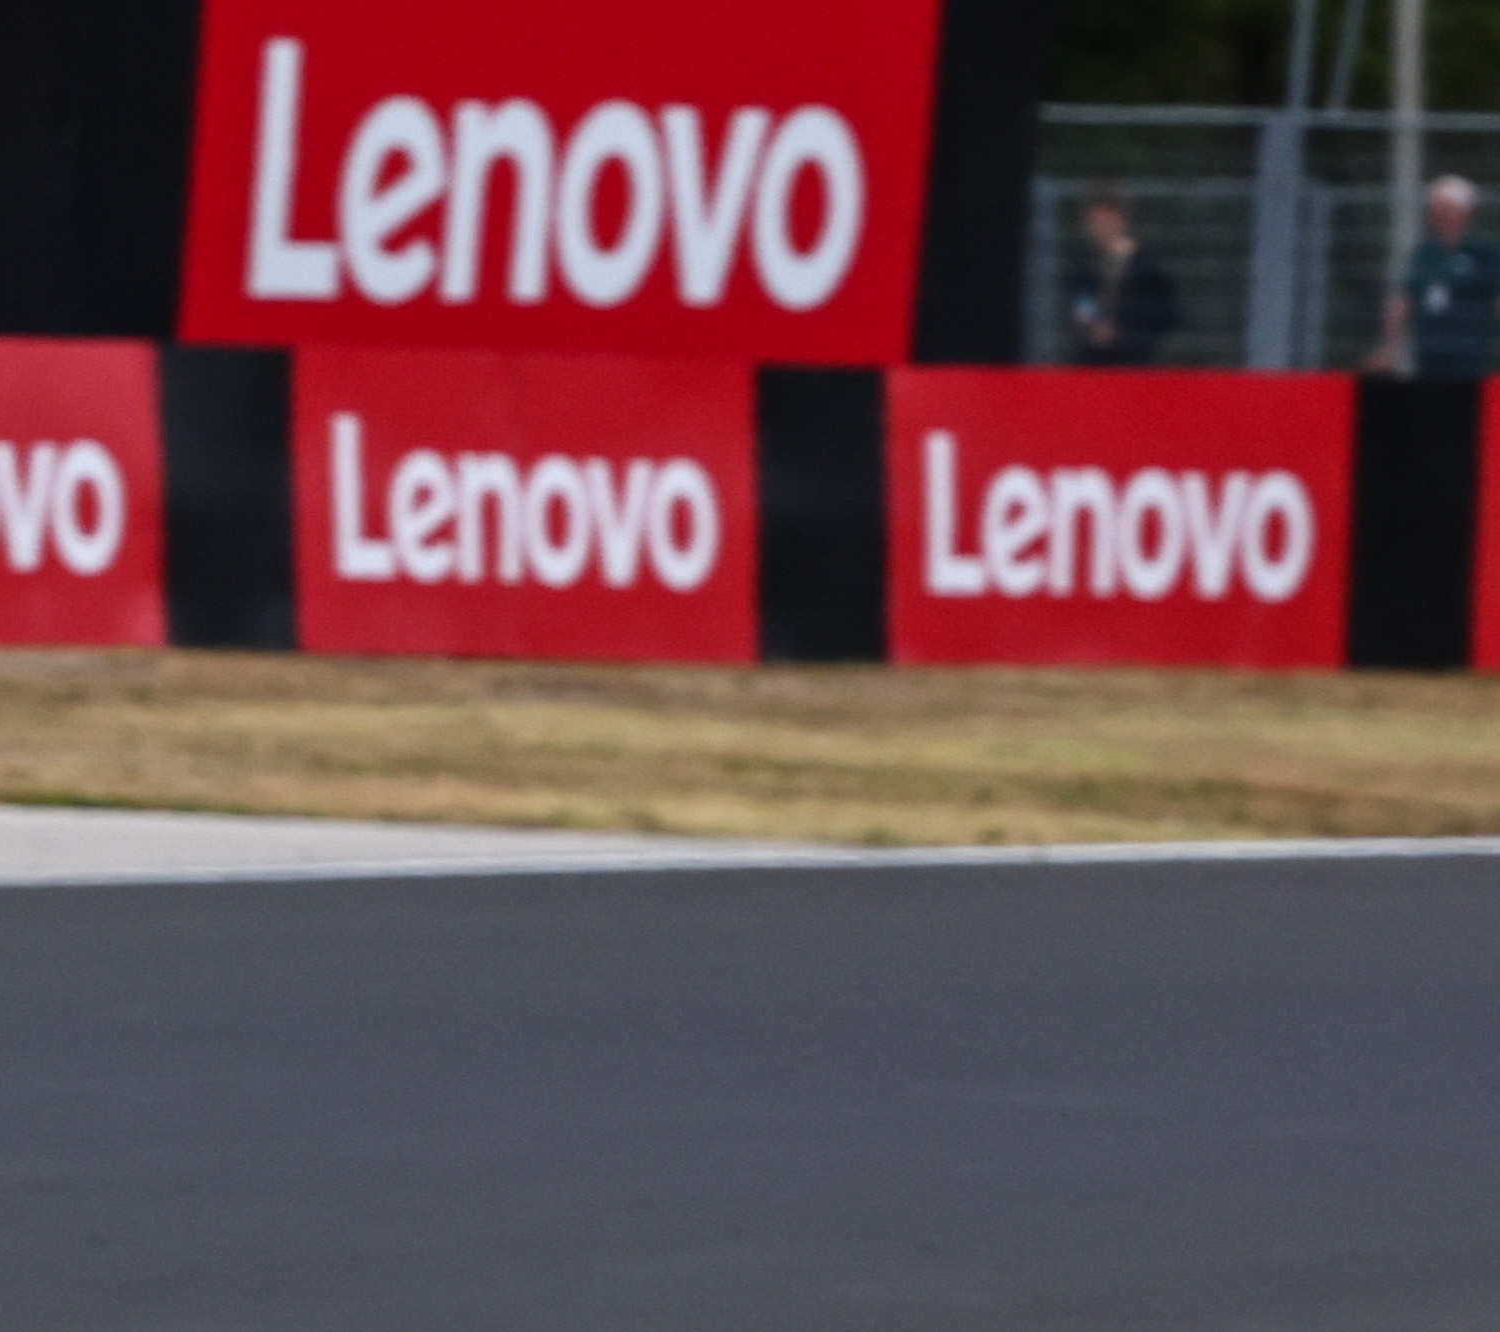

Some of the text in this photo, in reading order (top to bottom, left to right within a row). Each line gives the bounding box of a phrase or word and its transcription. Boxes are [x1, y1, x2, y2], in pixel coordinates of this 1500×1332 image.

[246, 38, 864, 310] Lenovo
[329, 413, 721, 591] Lenovo
[923, 431, 1314, 601] Lenovo
